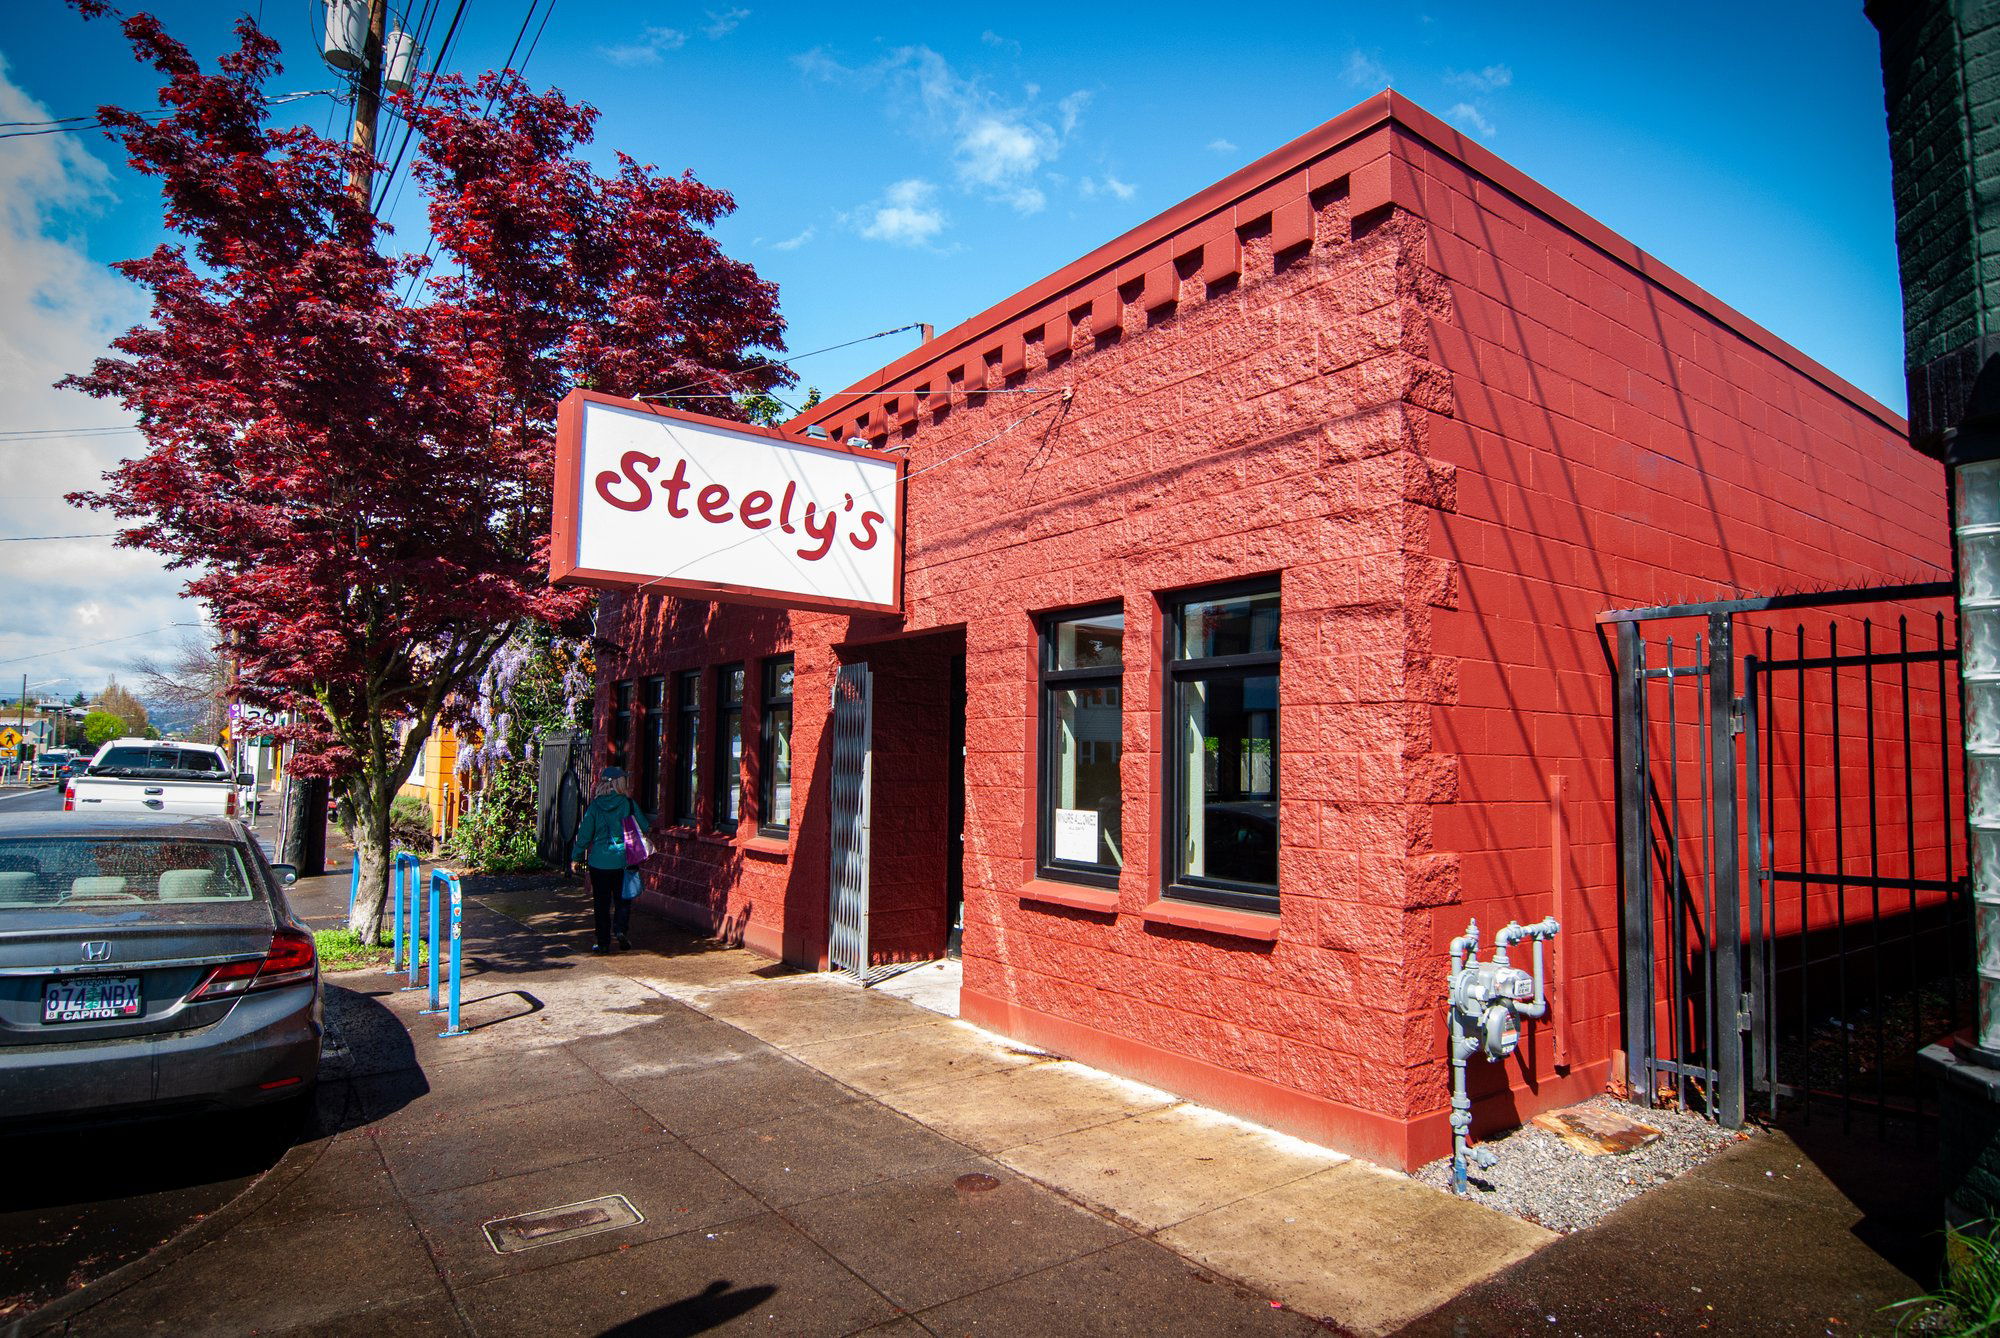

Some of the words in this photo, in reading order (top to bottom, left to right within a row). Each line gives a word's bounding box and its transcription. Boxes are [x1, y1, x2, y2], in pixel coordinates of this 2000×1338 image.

[595, 450, 885, 562] Steely's
[47, 987, 86, 1011] 874
[100, 984, 138, 1008] NBX
[62, 1008, 118, 1020] CAPITOL
